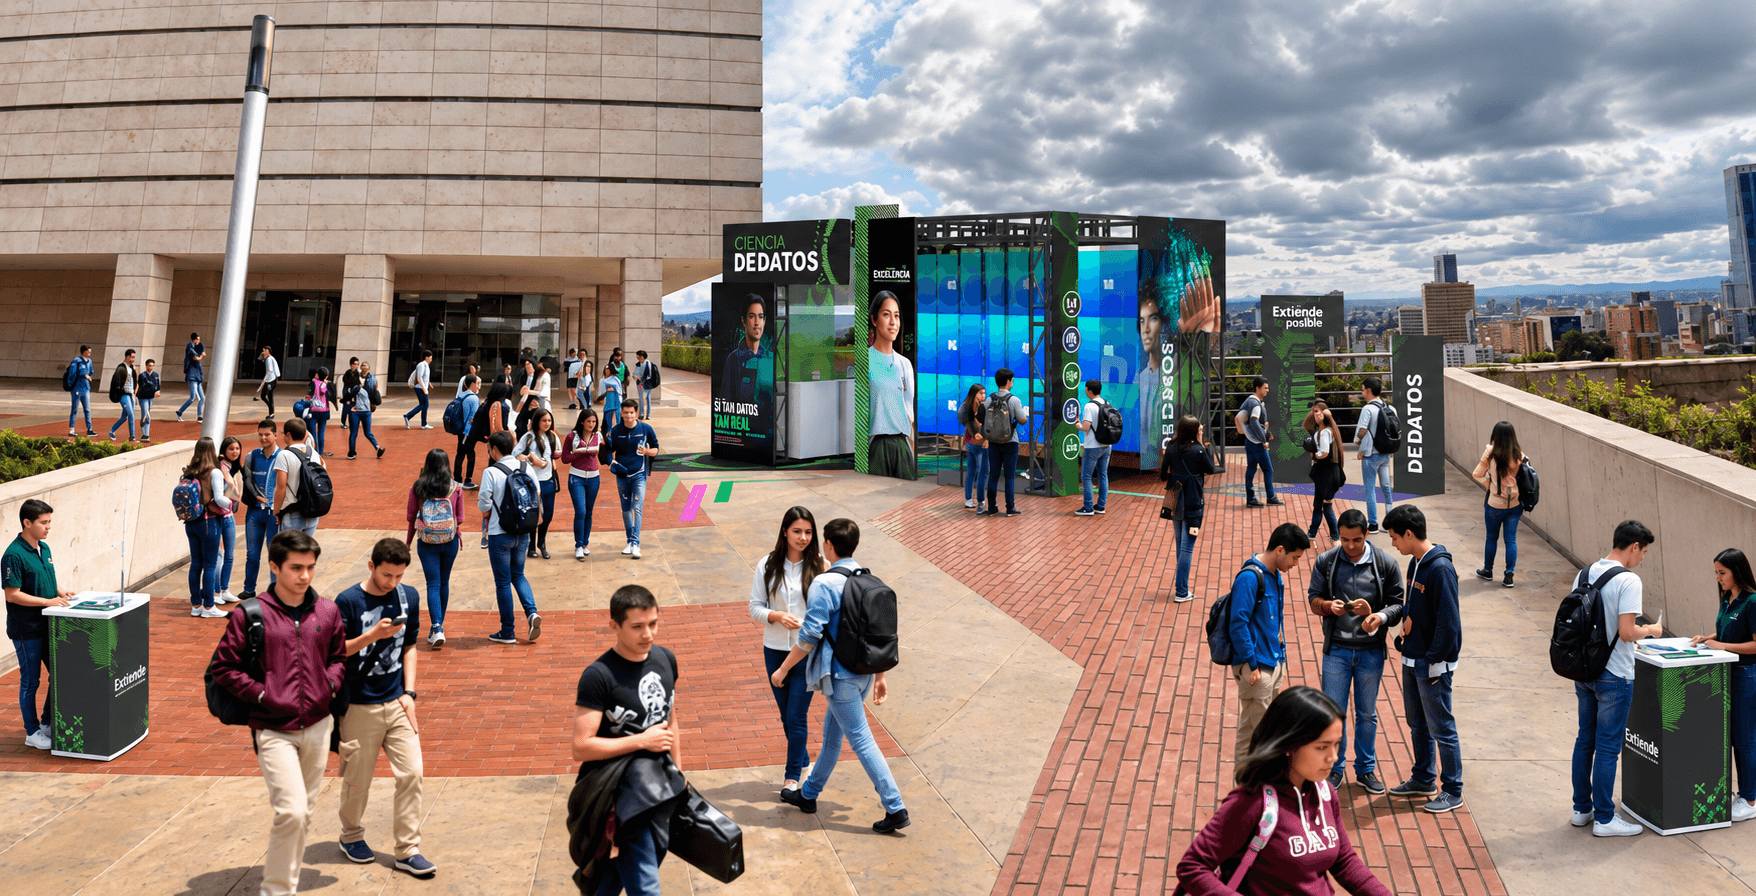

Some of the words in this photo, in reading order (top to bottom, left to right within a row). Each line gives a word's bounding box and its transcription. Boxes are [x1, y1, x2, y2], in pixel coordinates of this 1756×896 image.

[734, 235, 786, 250] CIENCIA
[734, 250, 819, 272] DEDATOS
[730, 415, 751, 431] REAL
[1406, 374, 1423, 474] DEDATOS
[114, 664, 147, 692] Extiende
[1625, 727, 1659, 758] Extiende
[1288, 826, 1339, 857] GAP
